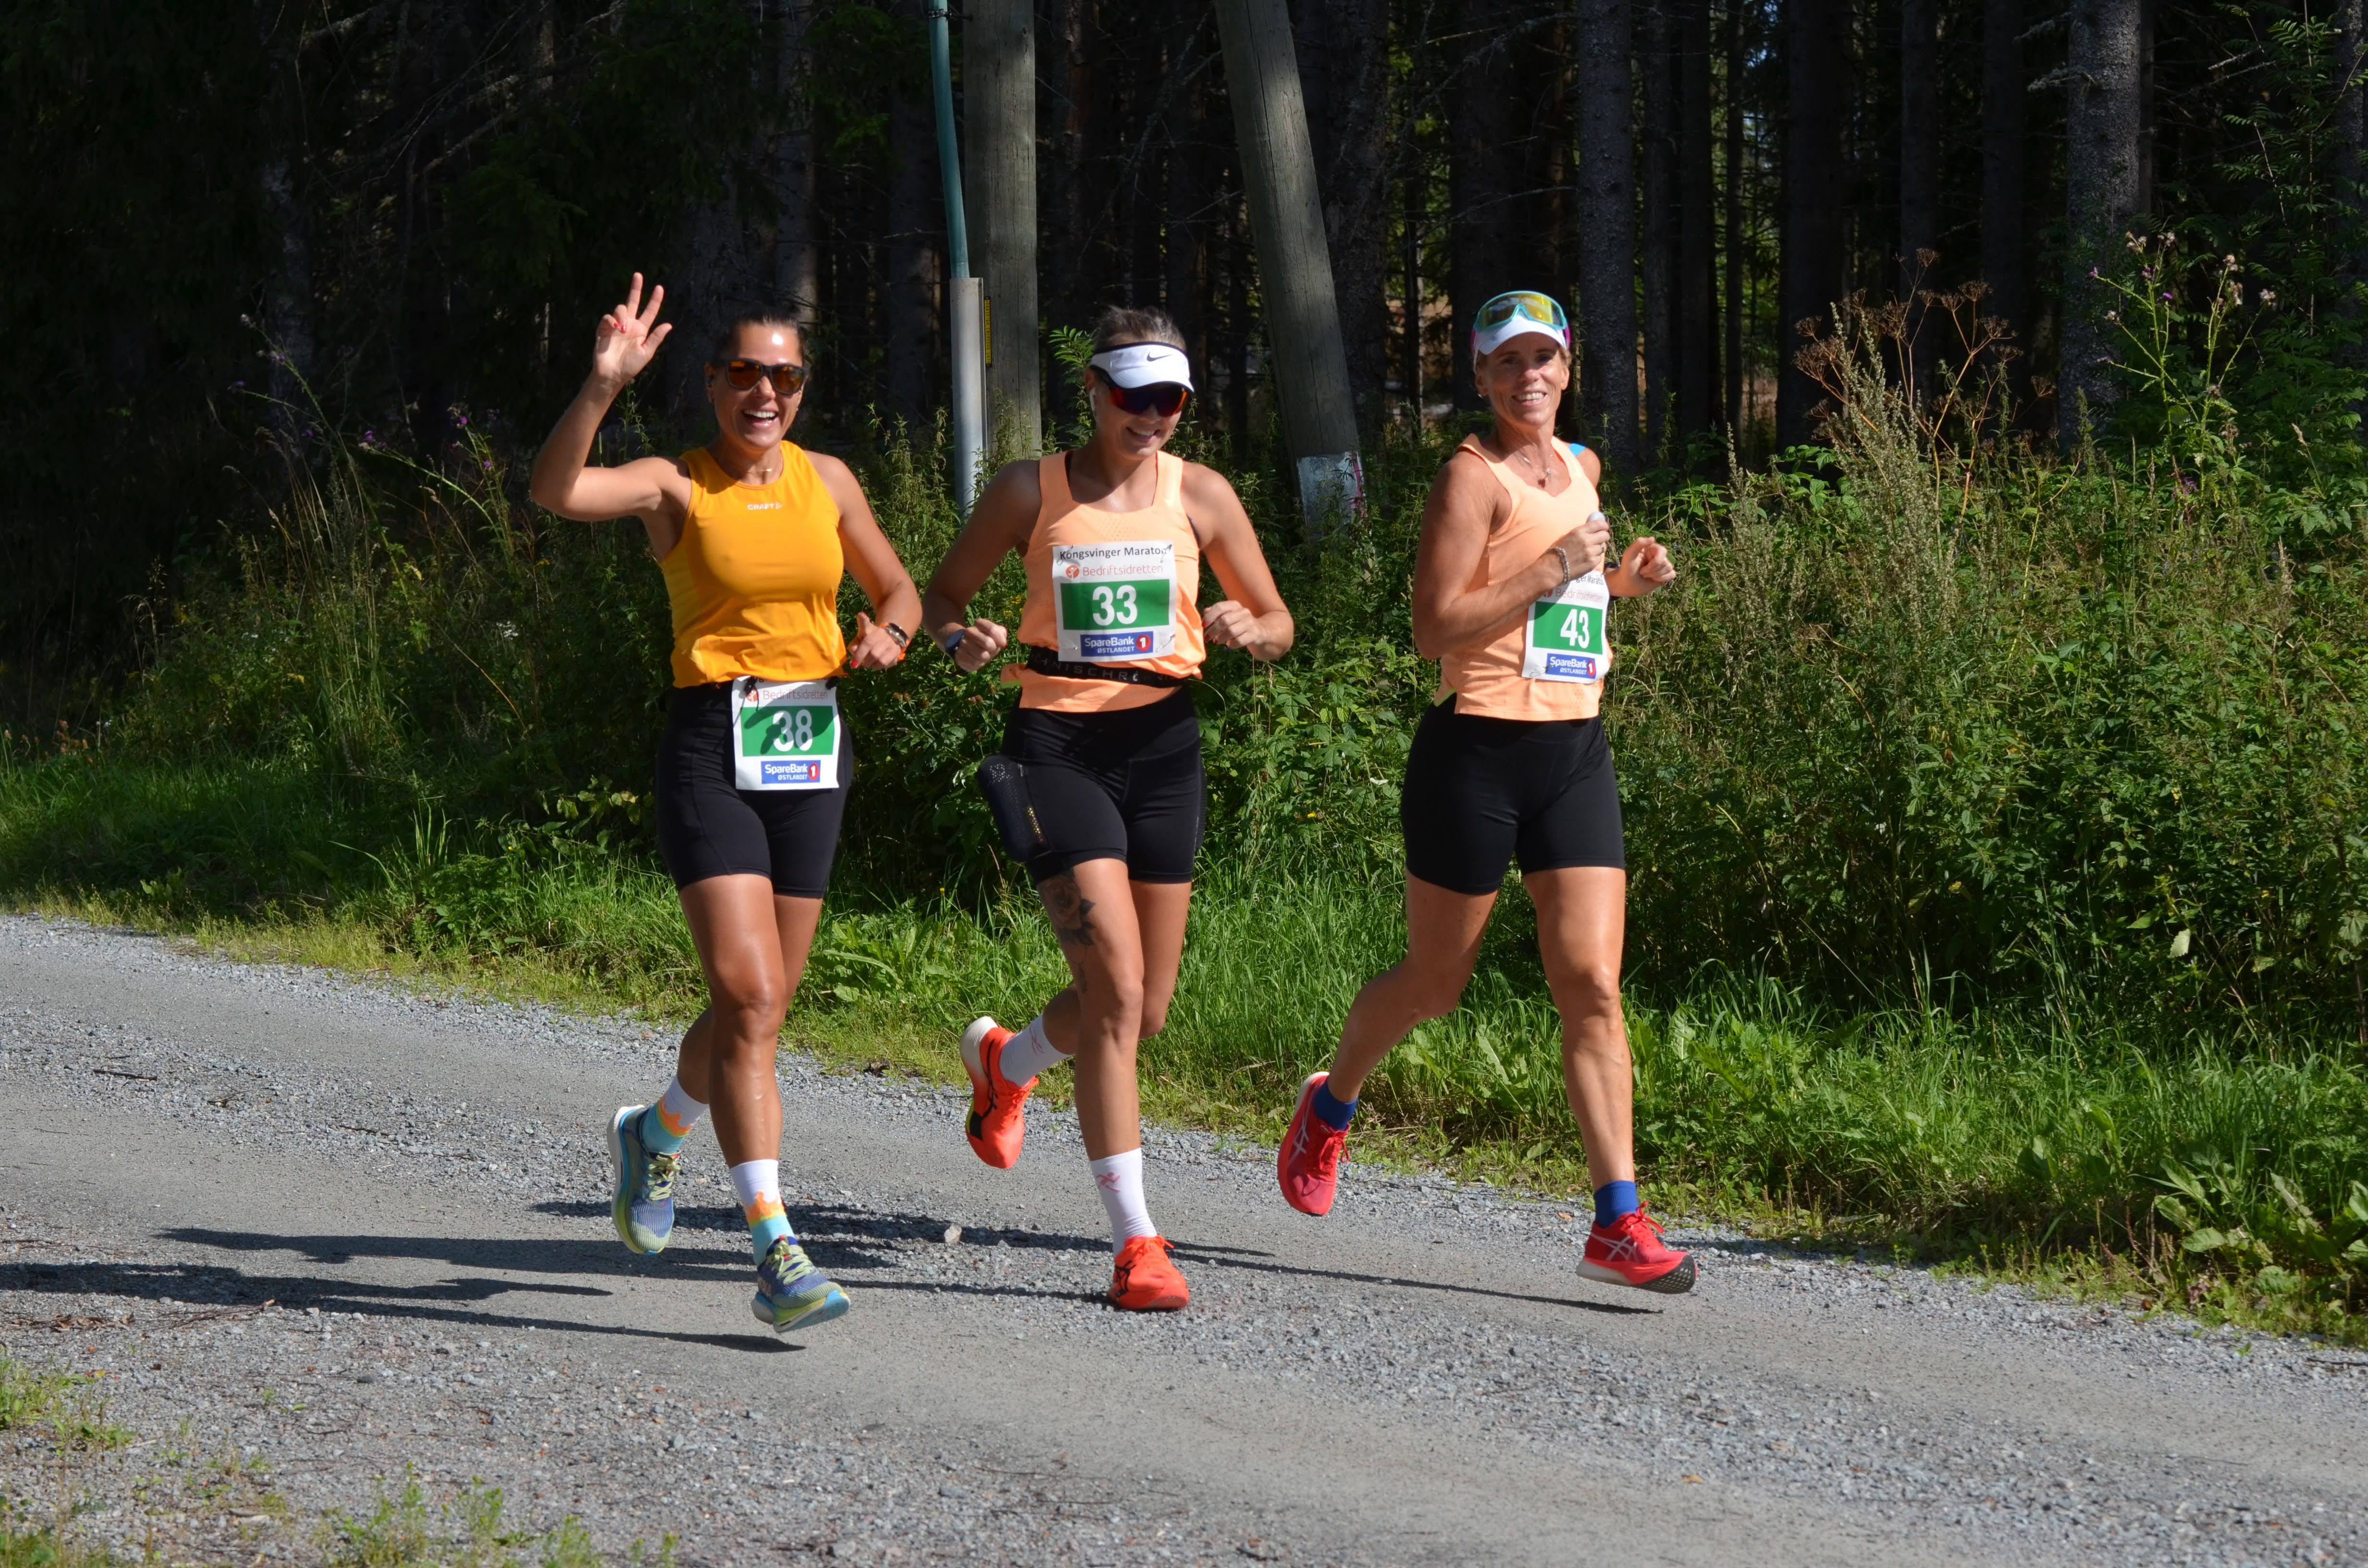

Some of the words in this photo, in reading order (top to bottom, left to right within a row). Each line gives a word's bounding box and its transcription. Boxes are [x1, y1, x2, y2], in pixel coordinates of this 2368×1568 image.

[1060, 548, 1121, 560] Kongsvinger
[1083, 564, 1163, 576] Bedriftsidretten
[1092, 585, 1138, 626] 33
[1560, 609, 1590, 649] 43
[1085, 635, 1135, 648] SpareBank
[1550, 656, 1587, 668] SpareBank
[763, 689, 828, 700] Bedriftsidretten
[773, 709, 813, 752] 38
[765, 764, 808, 774] SpareBank
